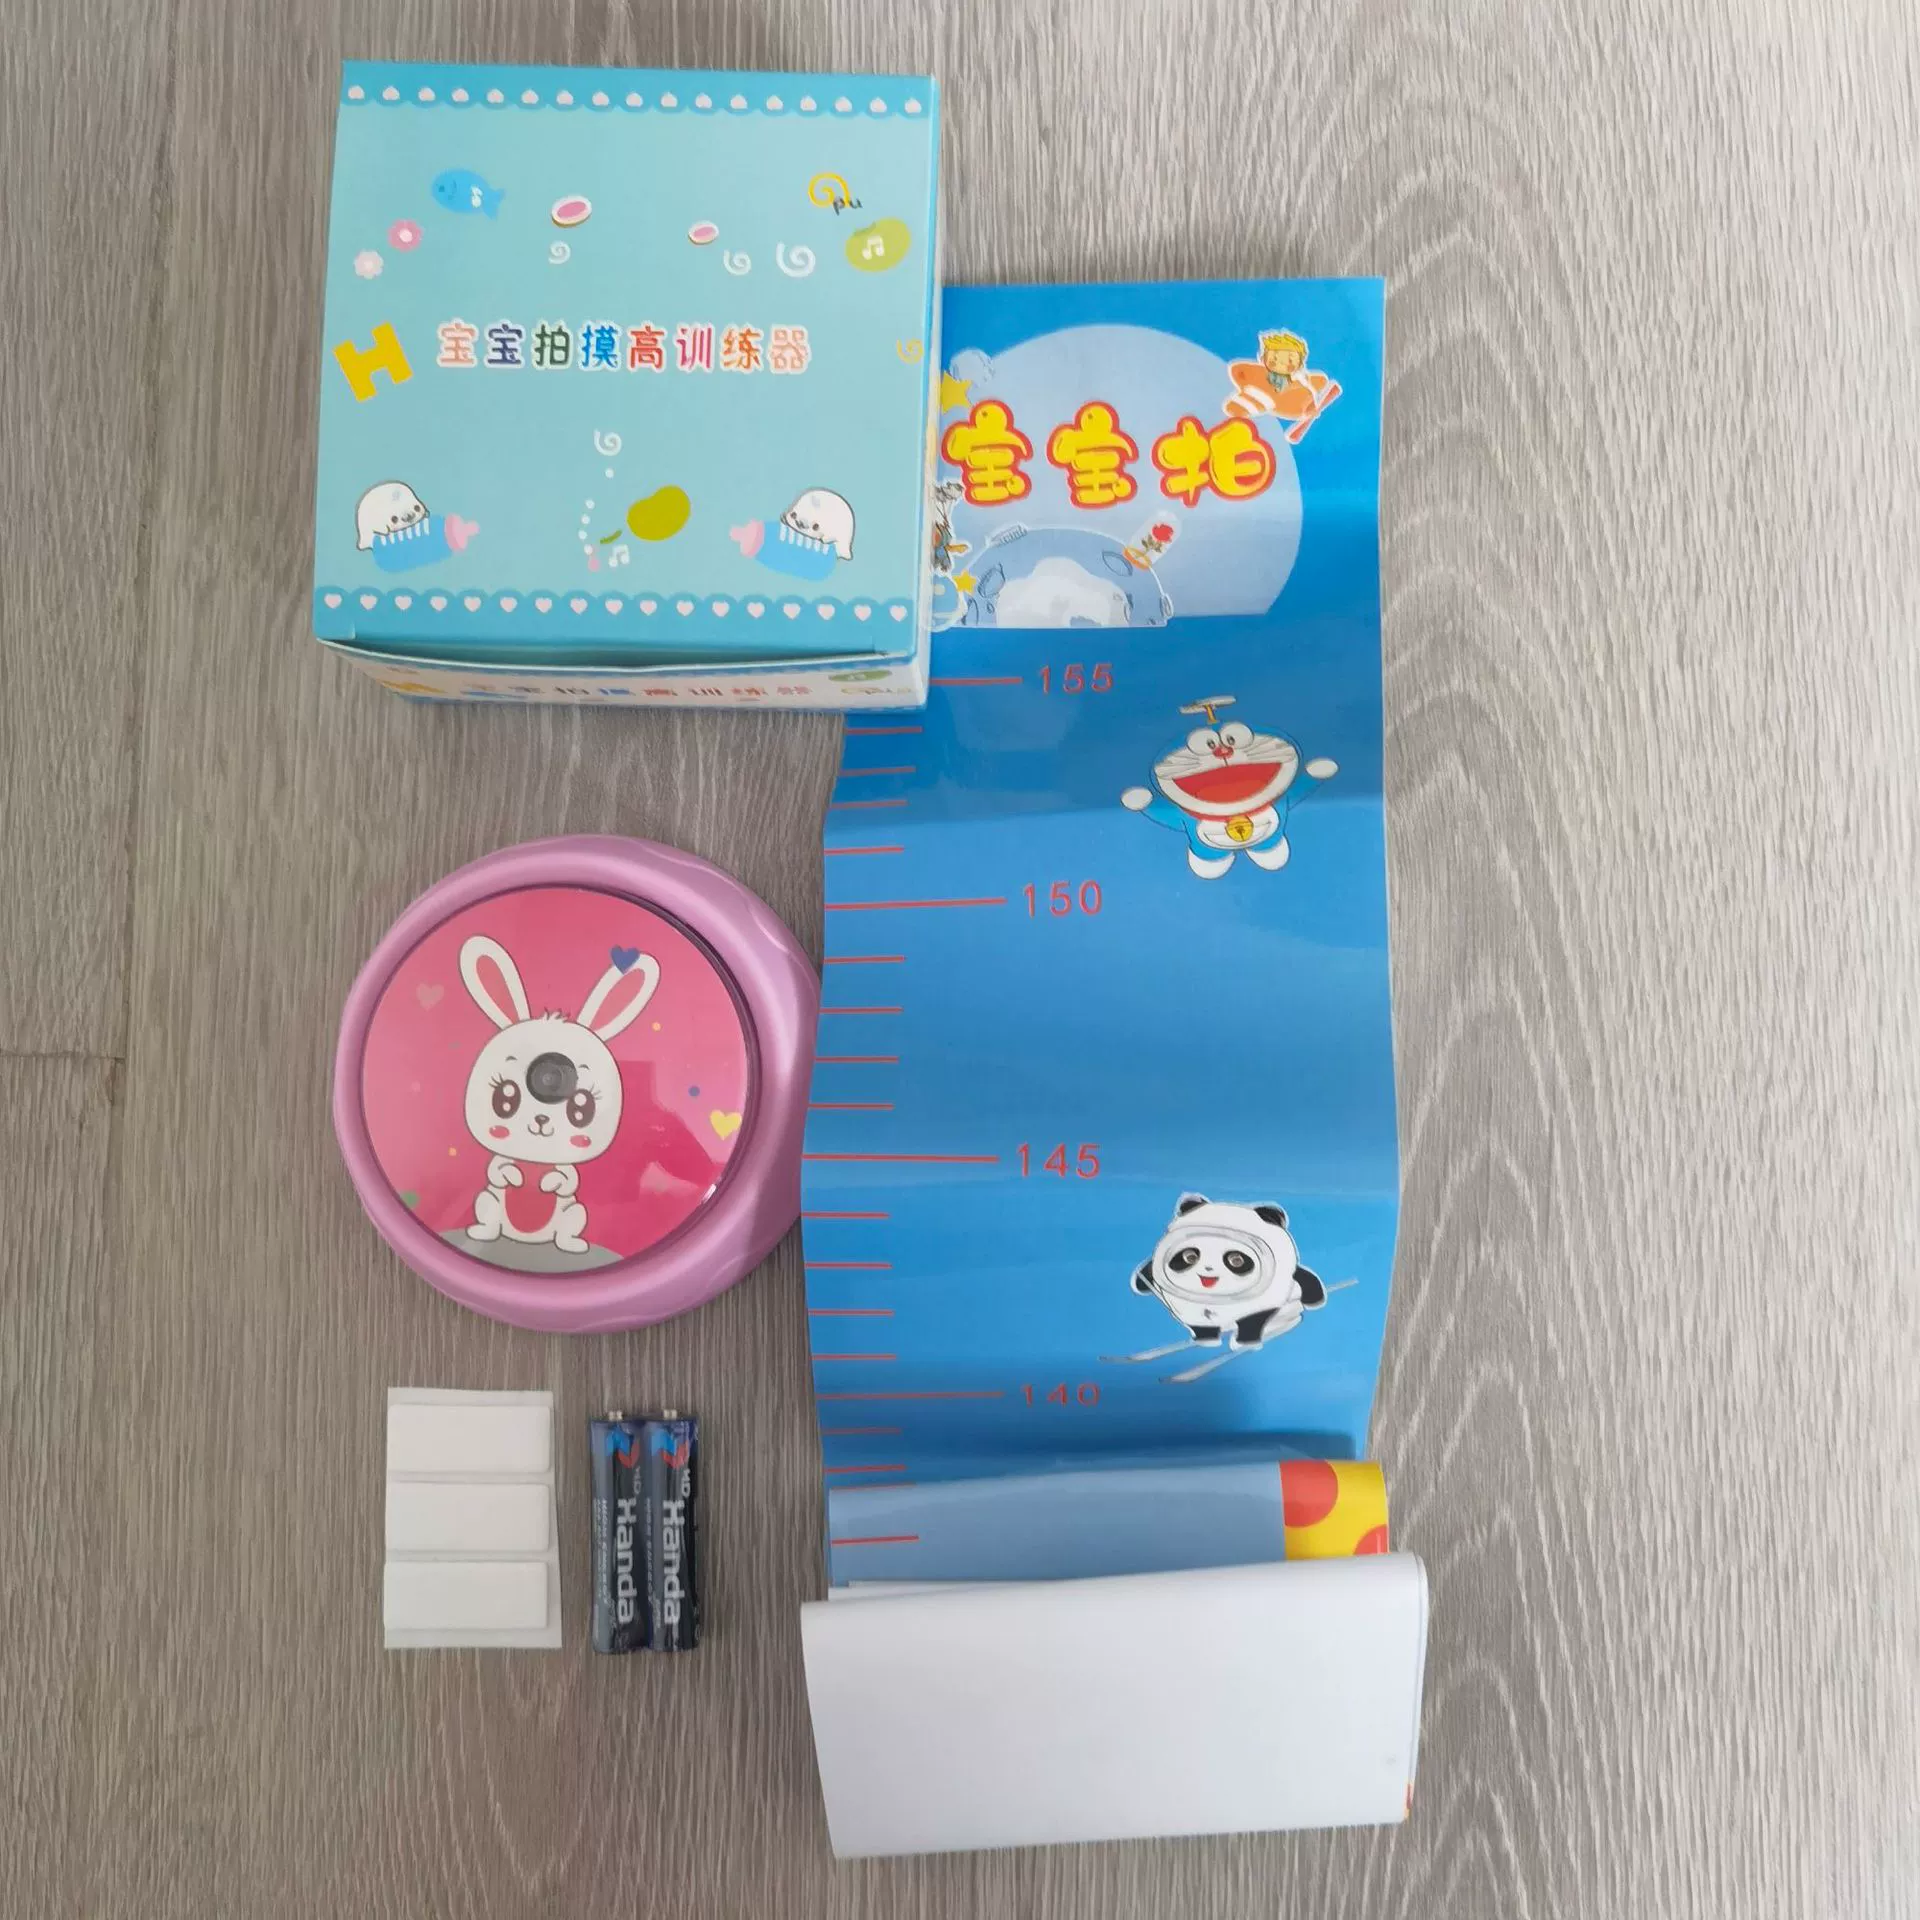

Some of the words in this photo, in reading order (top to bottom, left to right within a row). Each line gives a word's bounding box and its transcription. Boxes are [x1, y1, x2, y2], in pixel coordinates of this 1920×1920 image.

[438, 319, 811, 373] 宝宝拍摸高训练器
[941, 399, 1277, 508] 宝宝拍
[1039, 662, 1113, 694] 155
[1022, 879, 1102, 918] 150
[1016, 1143, 1101, 1179] 145
[1020, 1382, 1100, 1408] 140
[617, 1498, 637, 1625] Handa
[663, 1499, 685, 1625] Handa
